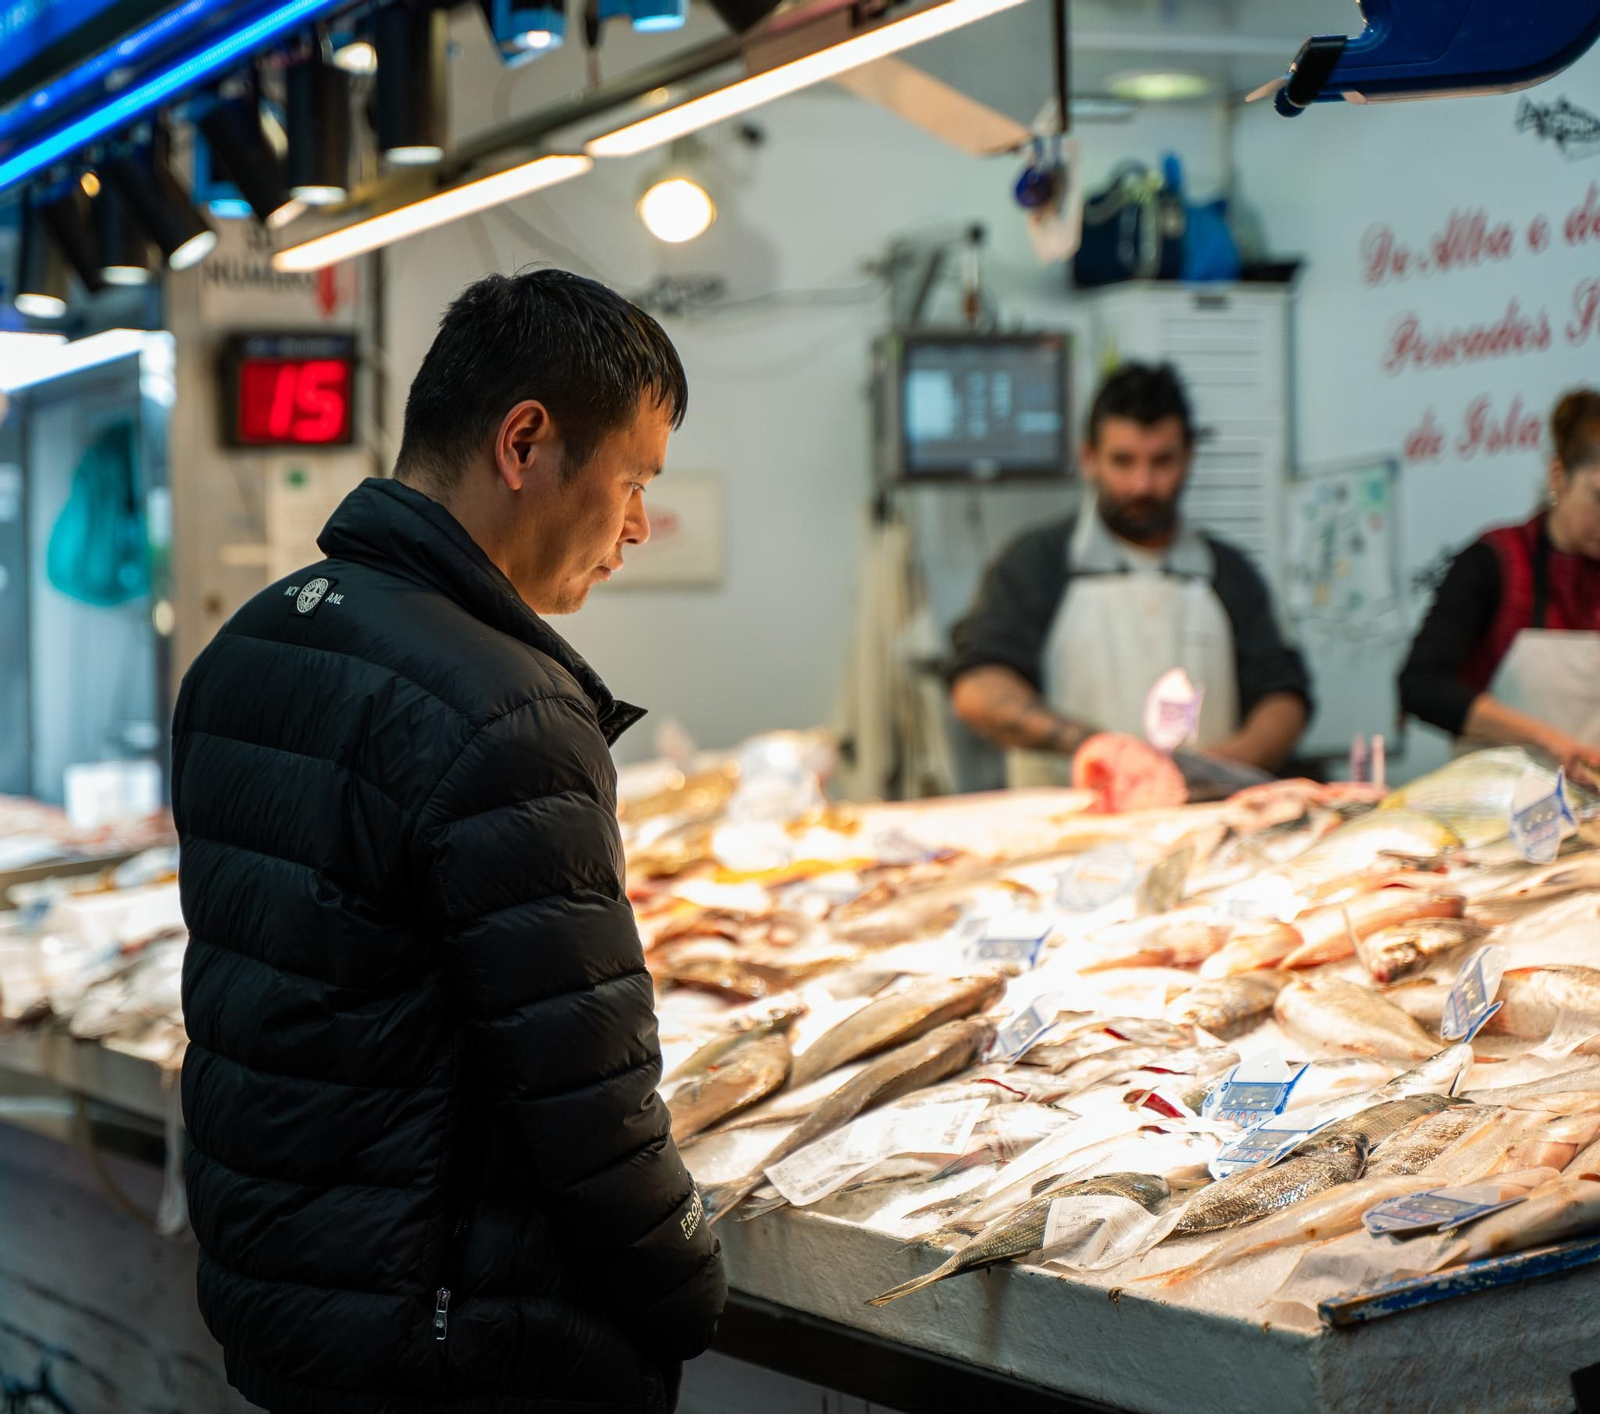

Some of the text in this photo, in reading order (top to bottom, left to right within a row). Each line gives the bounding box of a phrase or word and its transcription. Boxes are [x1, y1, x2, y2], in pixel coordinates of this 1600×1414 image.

[1383, 297, 1550, 376] Pescados
[268, 359, 346, 442] 15
[1457, 393, 1543, 460] Isla
[325, 592, 345, 605] ANL
